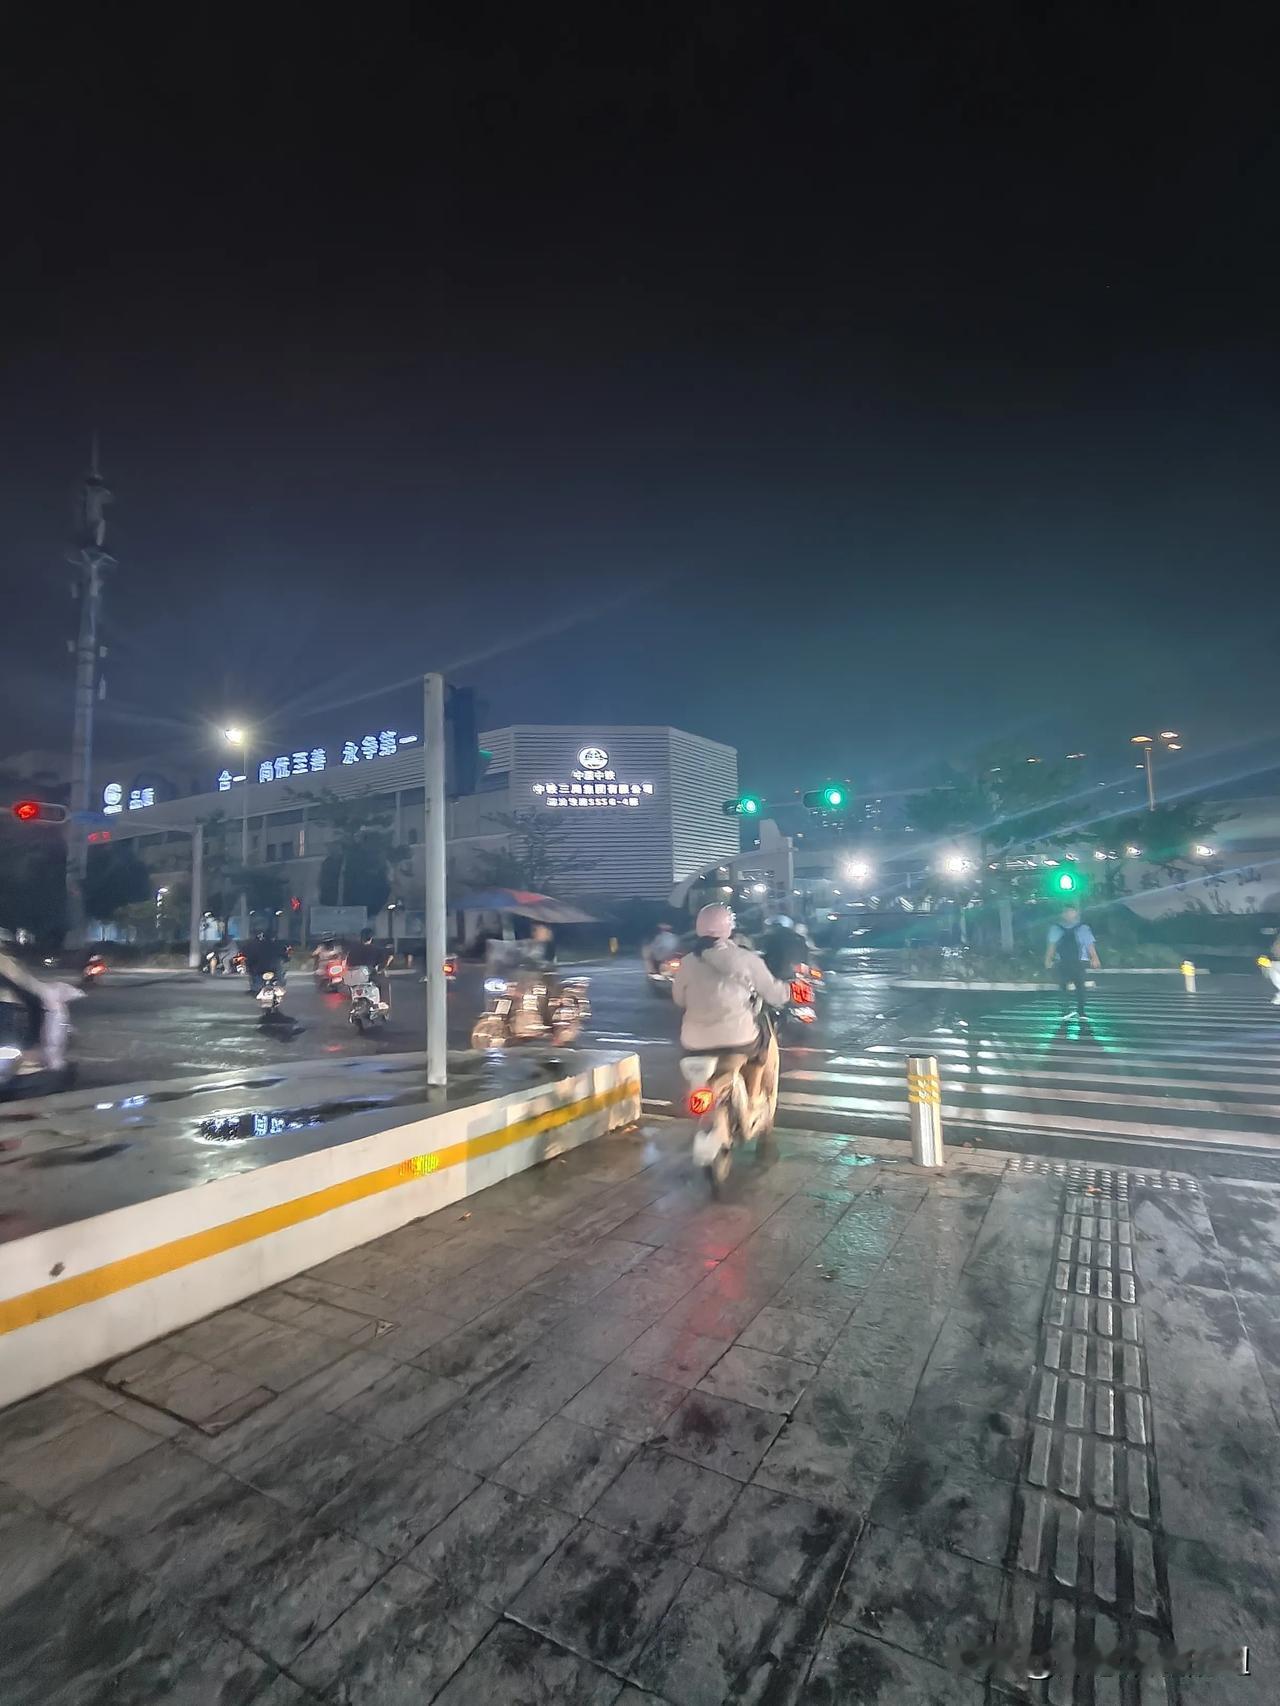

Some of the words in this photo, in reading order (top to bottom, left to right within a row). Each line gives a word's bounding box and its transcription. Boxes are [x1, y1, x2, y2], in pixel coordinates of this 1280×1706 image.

[342, 730, 418, 765] 永争第一
[572, 770, 617, 781] 中国中铁
[532, 783, 654, 795] 中铁三局集团有限公司
